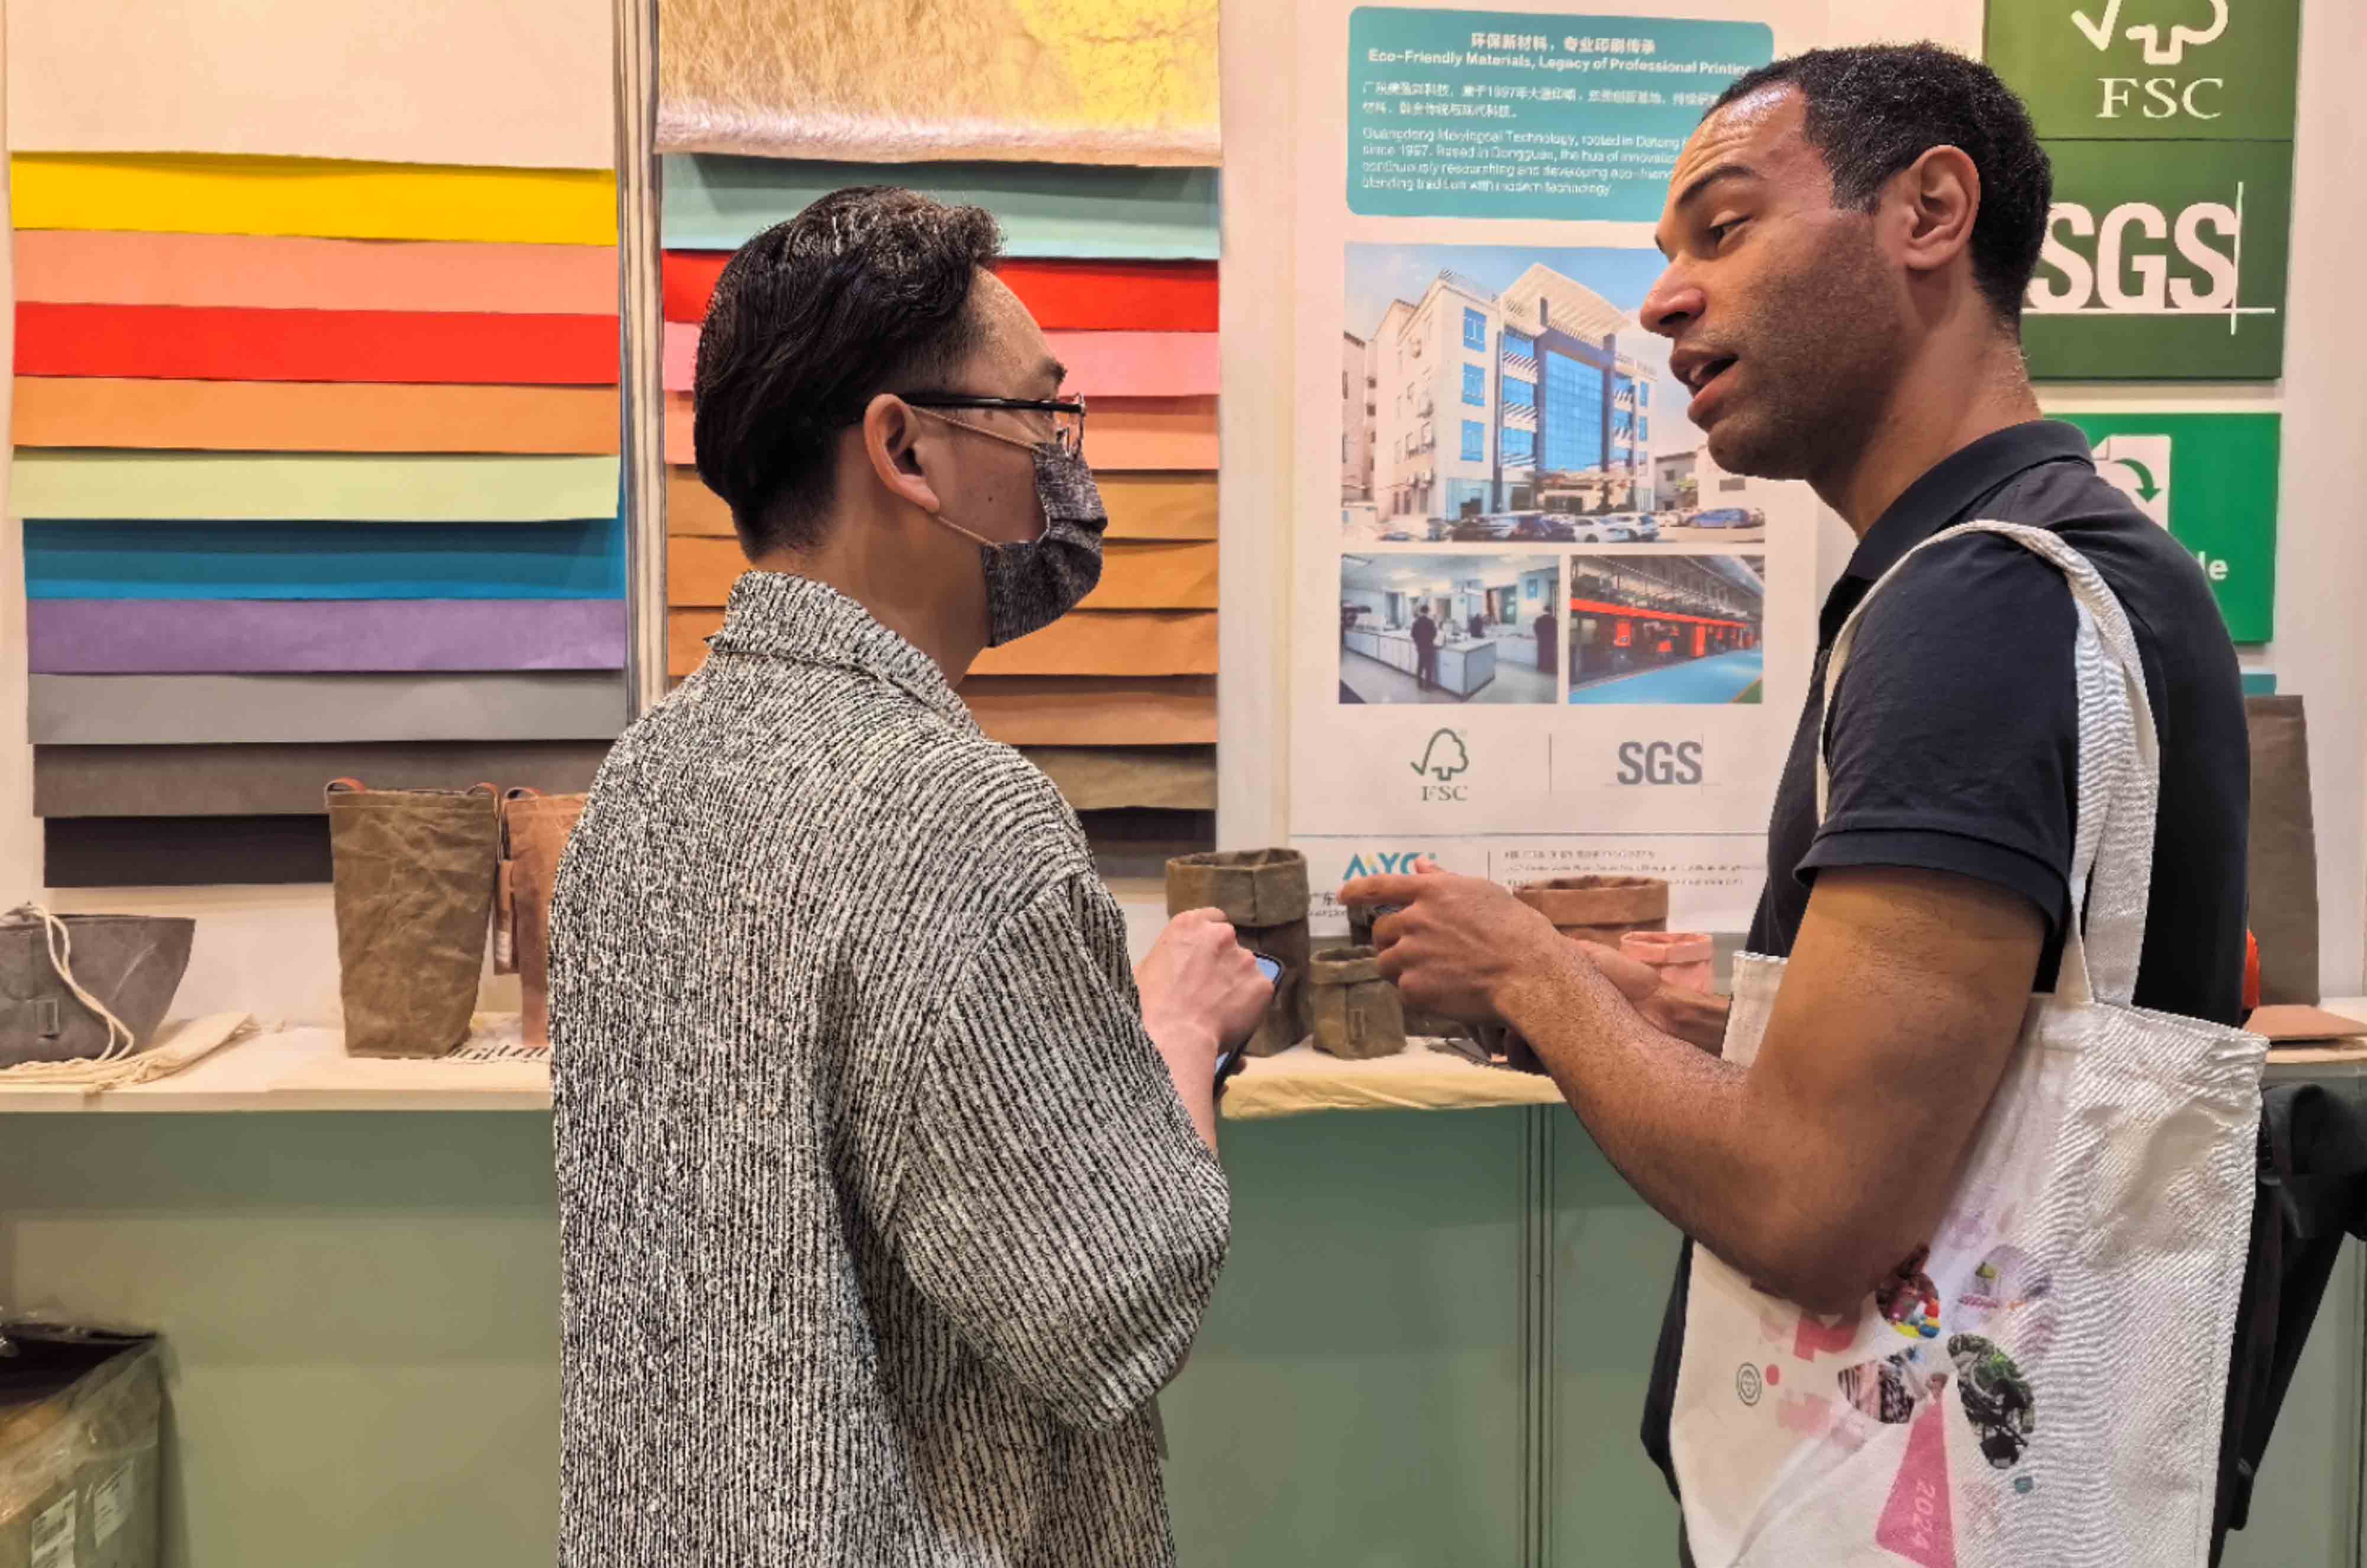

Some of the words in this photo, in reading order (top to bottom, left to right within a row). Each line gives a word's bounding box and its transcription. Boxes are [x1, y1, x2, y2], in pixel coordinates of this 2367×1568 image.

[1368, 47, 1462, 67] Eco-Friendly
[1466, 51, 1536, 70] Materials,
[1539, 55, 1591, 73] Legacy
[1593, 57, 1608, 69] of
[1610, 58, 1697, 73] Professional
[2095, 77, 2224, 120] FSC
[2026, 201, 2239, 312] SGS
[1617, 741, 1702, 785] SGS
[1421, 785, 1468, 801] FSC
[1911, 1479, 1936, 1549] 2024
